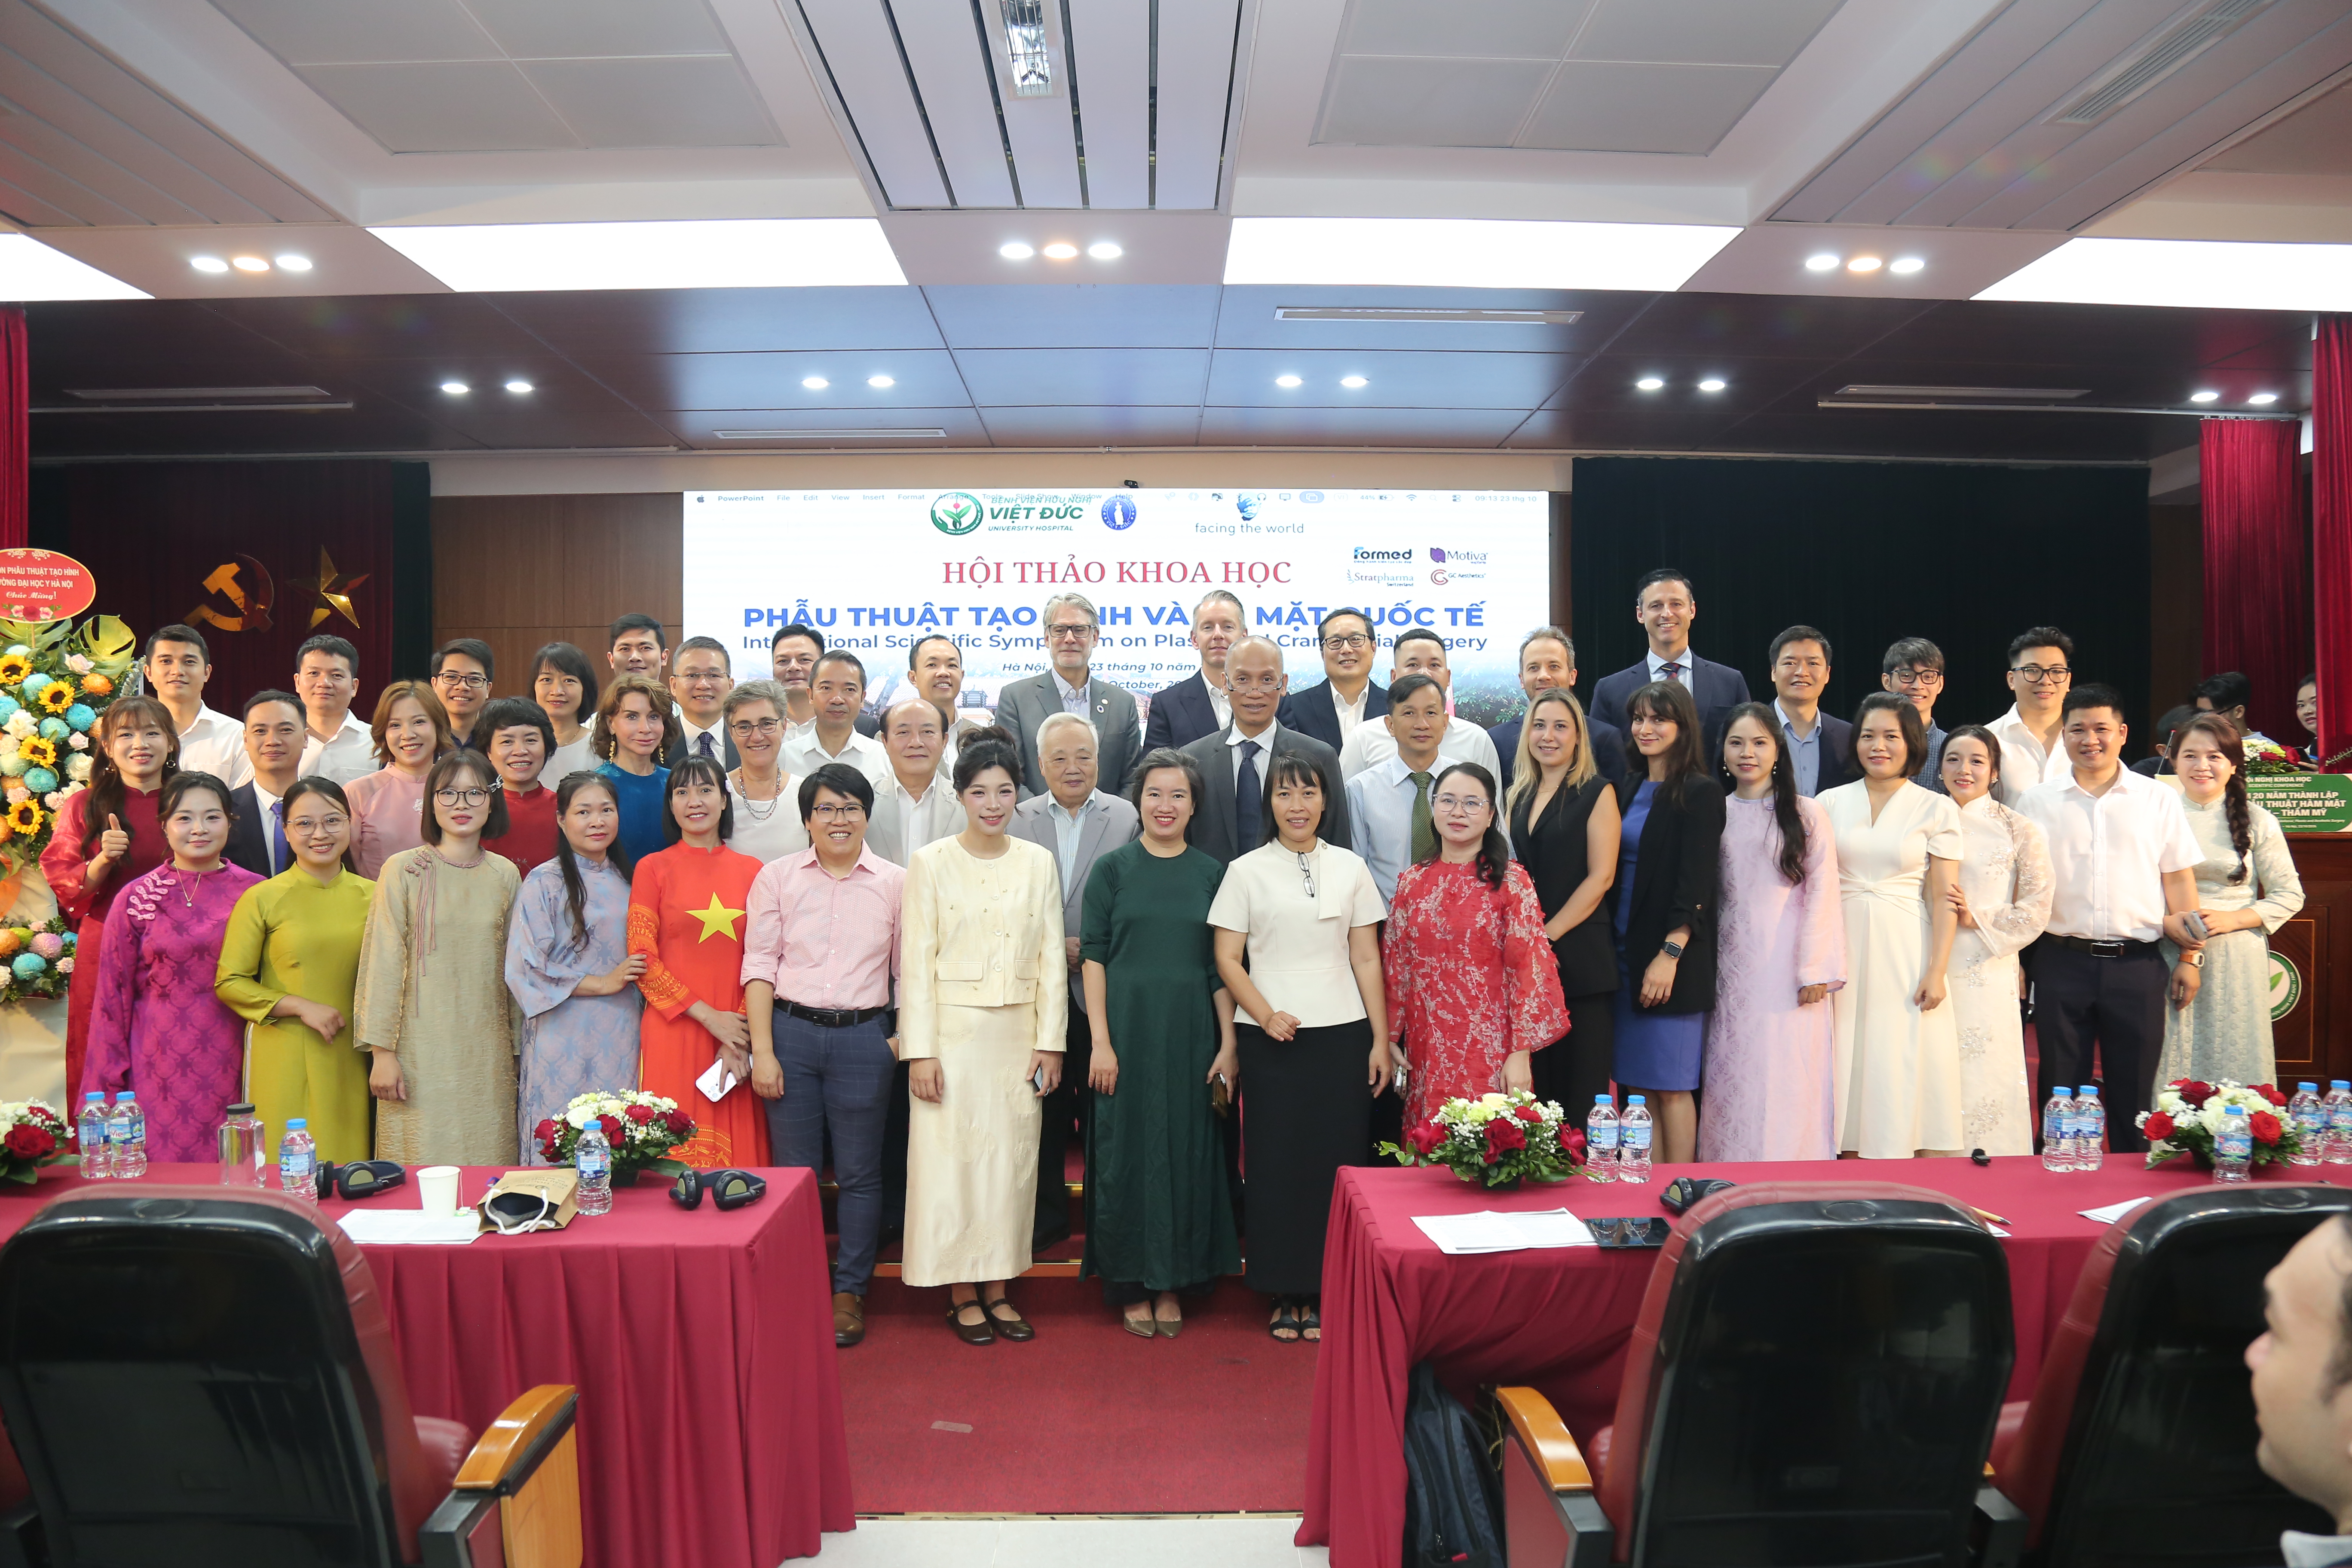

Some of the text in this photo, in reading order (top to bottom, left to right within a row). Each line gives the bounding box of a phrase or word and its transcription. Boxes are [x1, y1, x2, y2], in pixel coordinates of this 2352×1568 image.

[989, 504, 1036, 524] VIỆT
[1039, 503, 1084, 520] ĐỨC
[1195, 523, 1304, 536] facing the world
[1354, 546, 1412, 560] Formed
[7, 566, 25, 575] PHẪU
[26, 567, 48, 577] THUẬT
[49, 568, 63, 577] TẠO
[64, 567, 80, 576] HÌNH
[942, 554, 1291, 589] HỘI THẢO KHOA HỌC
[1354, 572, 1414, 584] Stratpharma
[18, 579, 29, 588] ĐẠI
[30, 580, 44, 589] HỌC
[51, 579, 61, 588] HÀ
[61, 579, 74, 590] NỘI
[744, 598, 836, 627] PHẪU
[847, 601, 959, 632] THUẬT
[968, 606, 1037, 632] TẠO
[1142, 601, 1190, 625] VÀ
[1256, 601, 1328, 632] MẶT
[1340, 600, 1435, 627] UỐC
[1444, 600, 1487, 627] TẾ
[1121, 637, 1146, 647] on
[1002, 662, 1020, 671] Hà
[1024, 663, 1048, 674] Nội,
[1107, 662, 1146, 673] tháng
[1151, 663, 1163, 671] 10
[1167, 662, 1196, 671] năm
[1109, 680, 1163, 690] October,
[2266, 791, 2287, 799] NĂM
[2288, 790, 2319, 799] THÀNH
[2320, 790, 2340, 800] LẬP
[2265, 799, 2298, 809] THUẬT
[2299, 799, 2323, 807] HÀM
[2324, 799, 2347, 809] MẶT
[2280, 807, 2310, 816] THẨM
[2311, 808, 2328, 816] MỸ
